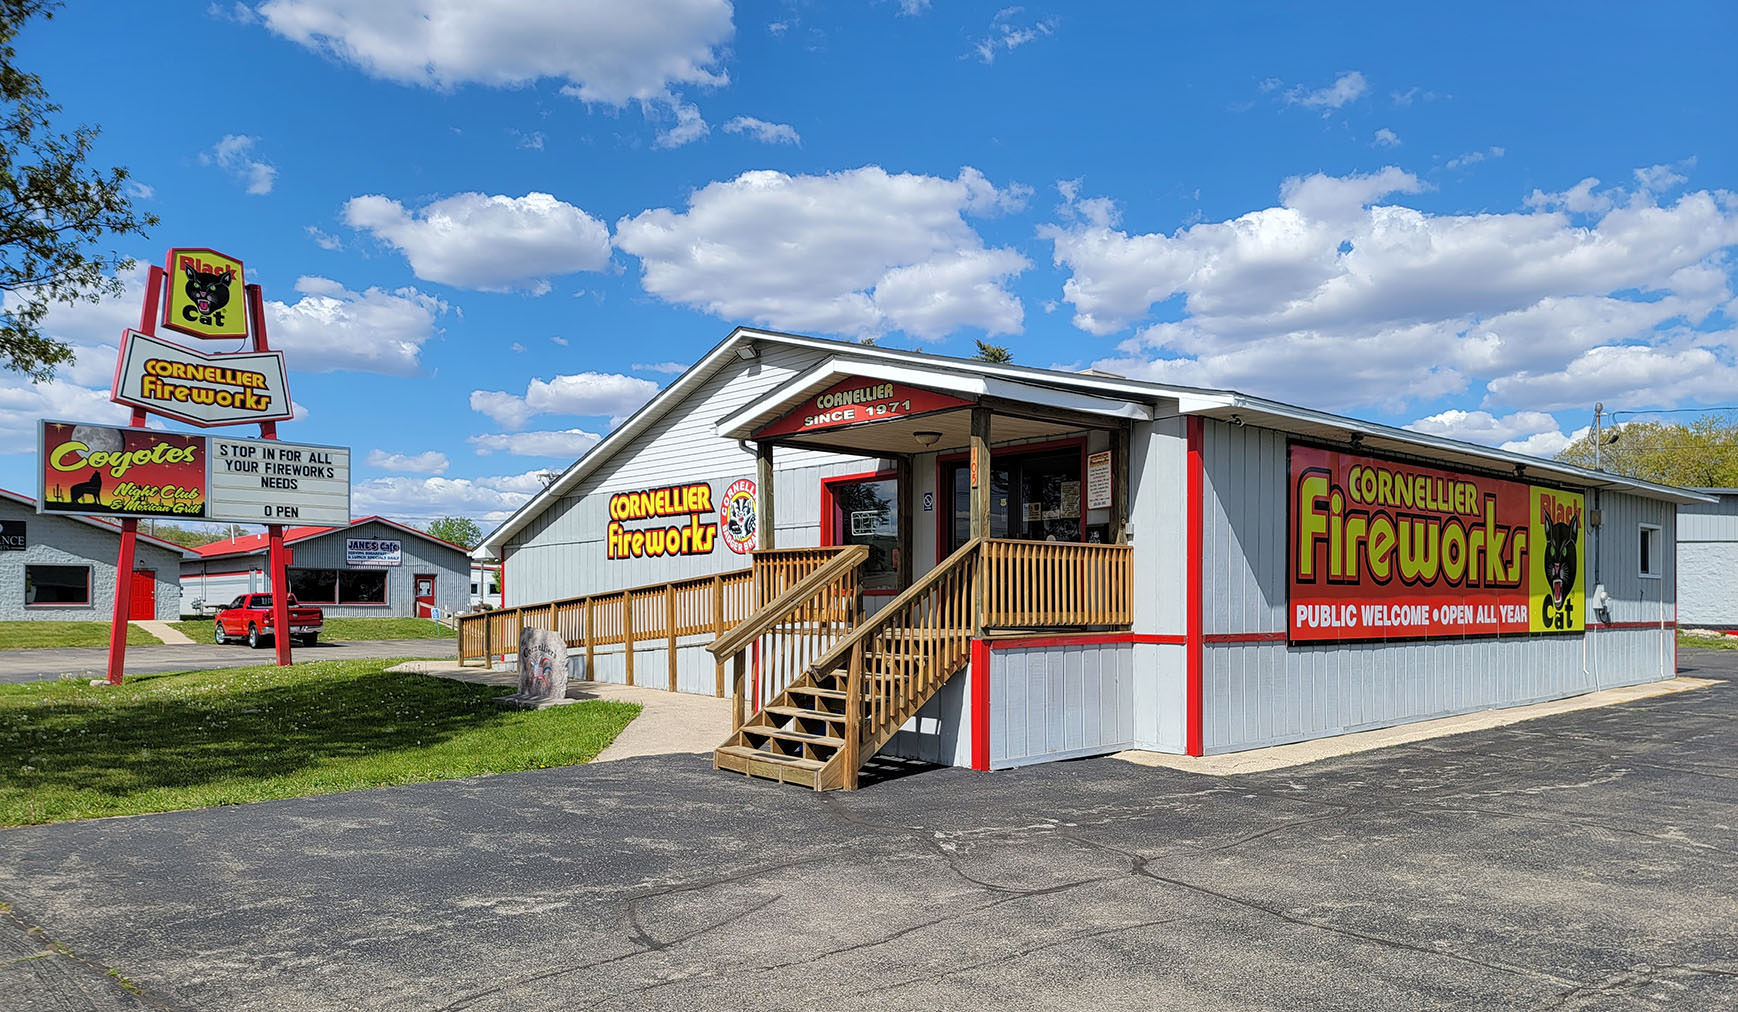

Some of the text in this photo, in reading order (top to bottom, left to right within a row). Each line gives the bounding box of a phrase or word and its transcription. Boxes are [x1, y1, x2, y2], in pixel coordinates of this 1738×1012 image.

[180, 255, 237, 280] Black
[182, 304, 225, 327] Cat
[144, 359, 269, 390] CORNELLIER
[142, 375, 271, 411] Fireworks
[816, 383, 894, 409] CORNELLIER
[804, 400, 910, 426] SINCE 1971
[50, 441, 198, 478] Coyotes
[220, 445, 332, 464] STOP IN FOR ALL
[226, 460, 334, 478] YOUR FIREWORKS
[113, 482, 199, 501] Night Club
[261, 477, 298, 489] NEEDS
[1347, 464, 1481, 517] CORNELLIER
[111, 500, 201, 513] & Mexican Grill
[264, 506, 298, 518] OPEN
[609, 482, 715, 522] CORNELLIER
[721, 481, 757, 517] CORNELL
[1540, 493, 1581, 528] Black
[0, 535, 25, 546] NCE
[607, 513, 717, 560] Fireworks
[1297, 467, 1529, 588] Fireworks
[1296, 605, 1528, 628] PUBLIC WELCOME OPEN ALL YEAR
[1542, 594, 1573, 629] Cat
